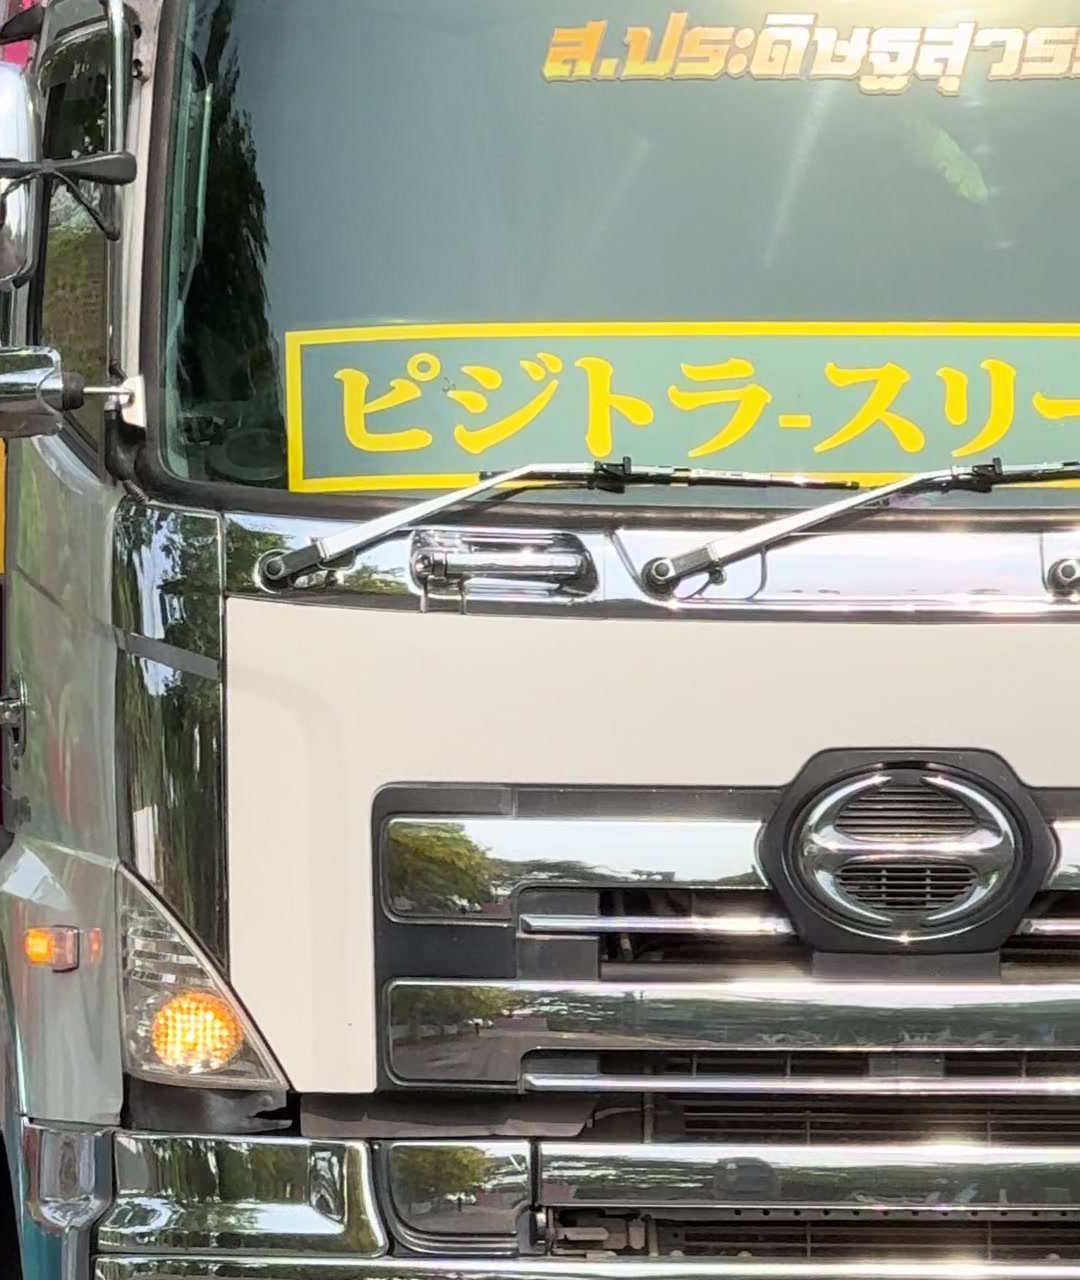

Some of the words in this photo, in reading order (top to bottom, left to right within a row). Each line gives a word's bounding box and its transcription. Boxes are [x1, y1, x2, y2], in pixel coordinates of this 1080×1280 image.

[542, 11, 1080, 96] ส.ประดิษฐสุวร
